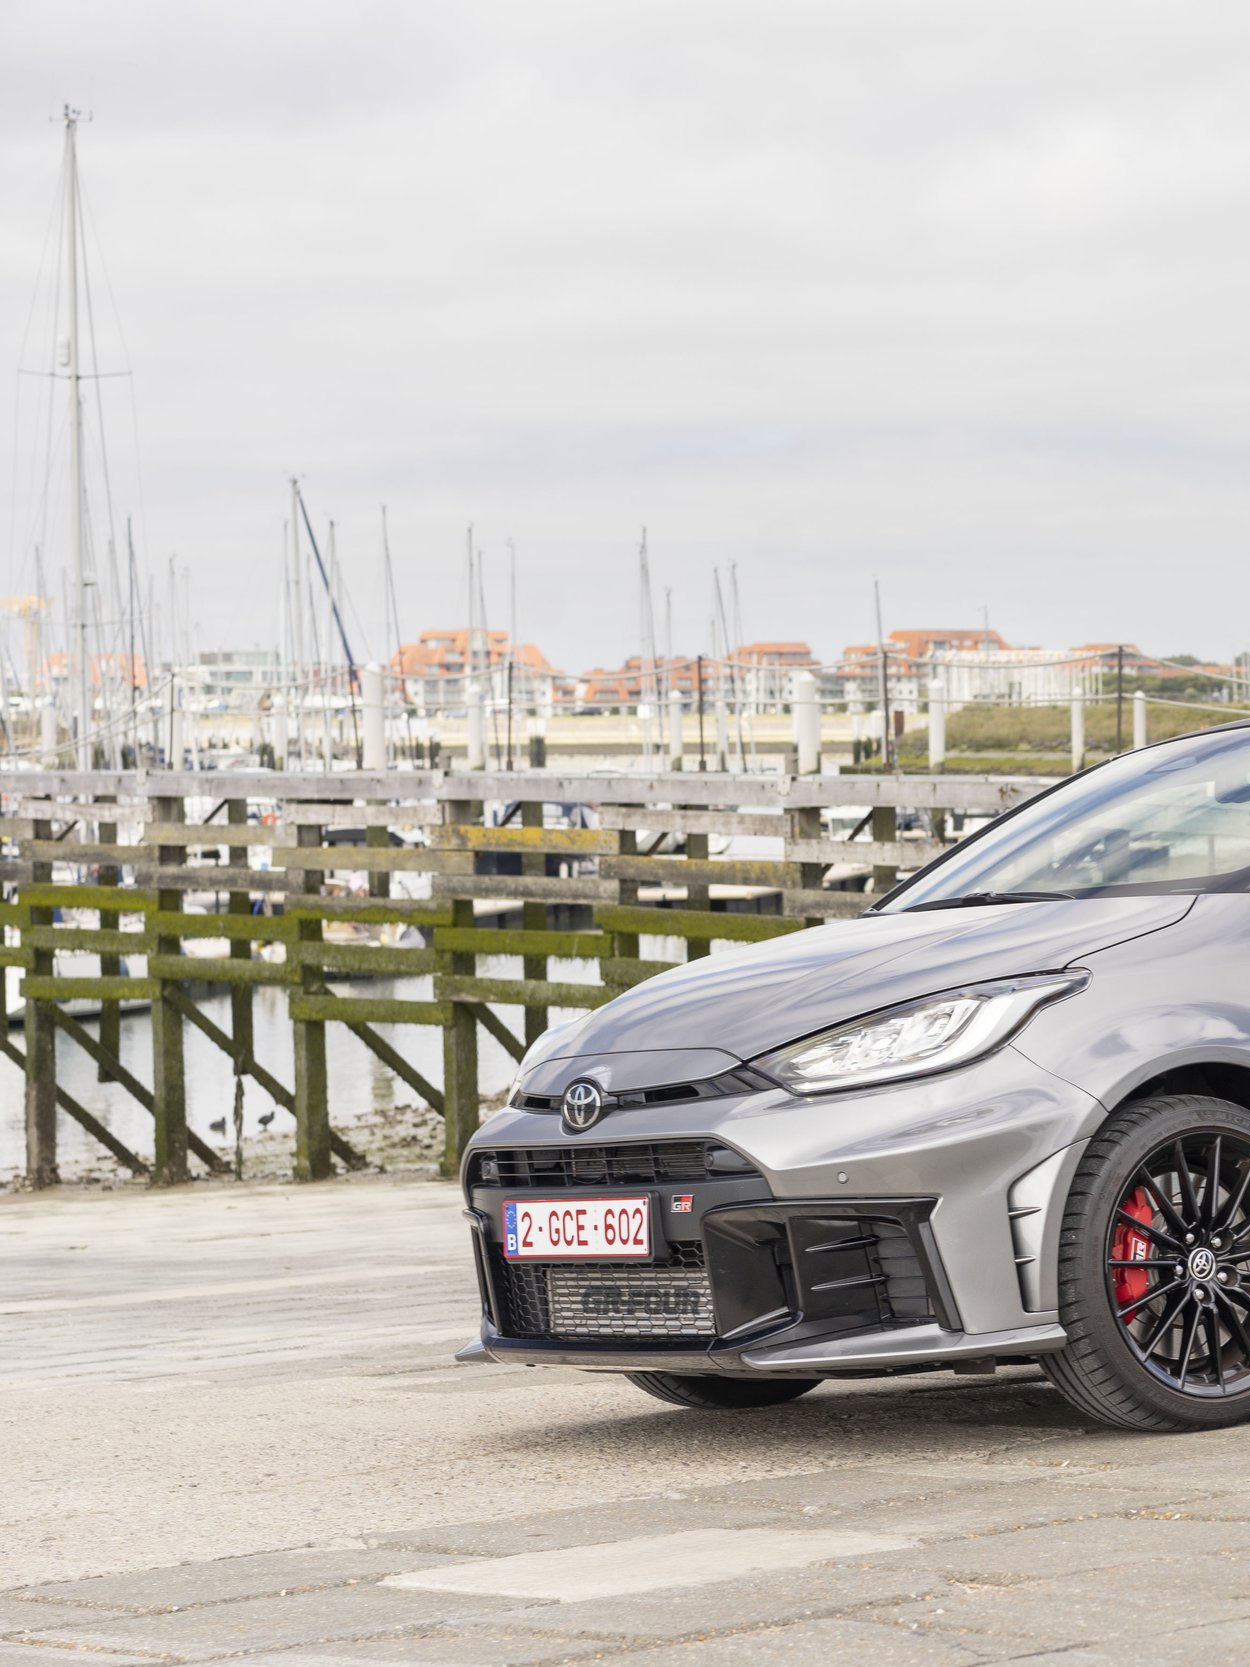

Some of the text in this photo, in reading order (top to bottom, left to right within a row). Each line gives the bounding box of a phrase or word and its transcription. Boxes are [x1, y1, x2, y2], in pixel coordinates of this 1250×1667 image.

[673, 1201, 692, 1211] GR
[521, 1207, 644, 1248] 2-GCE-602
[507, 1233, 517, 1251] B
